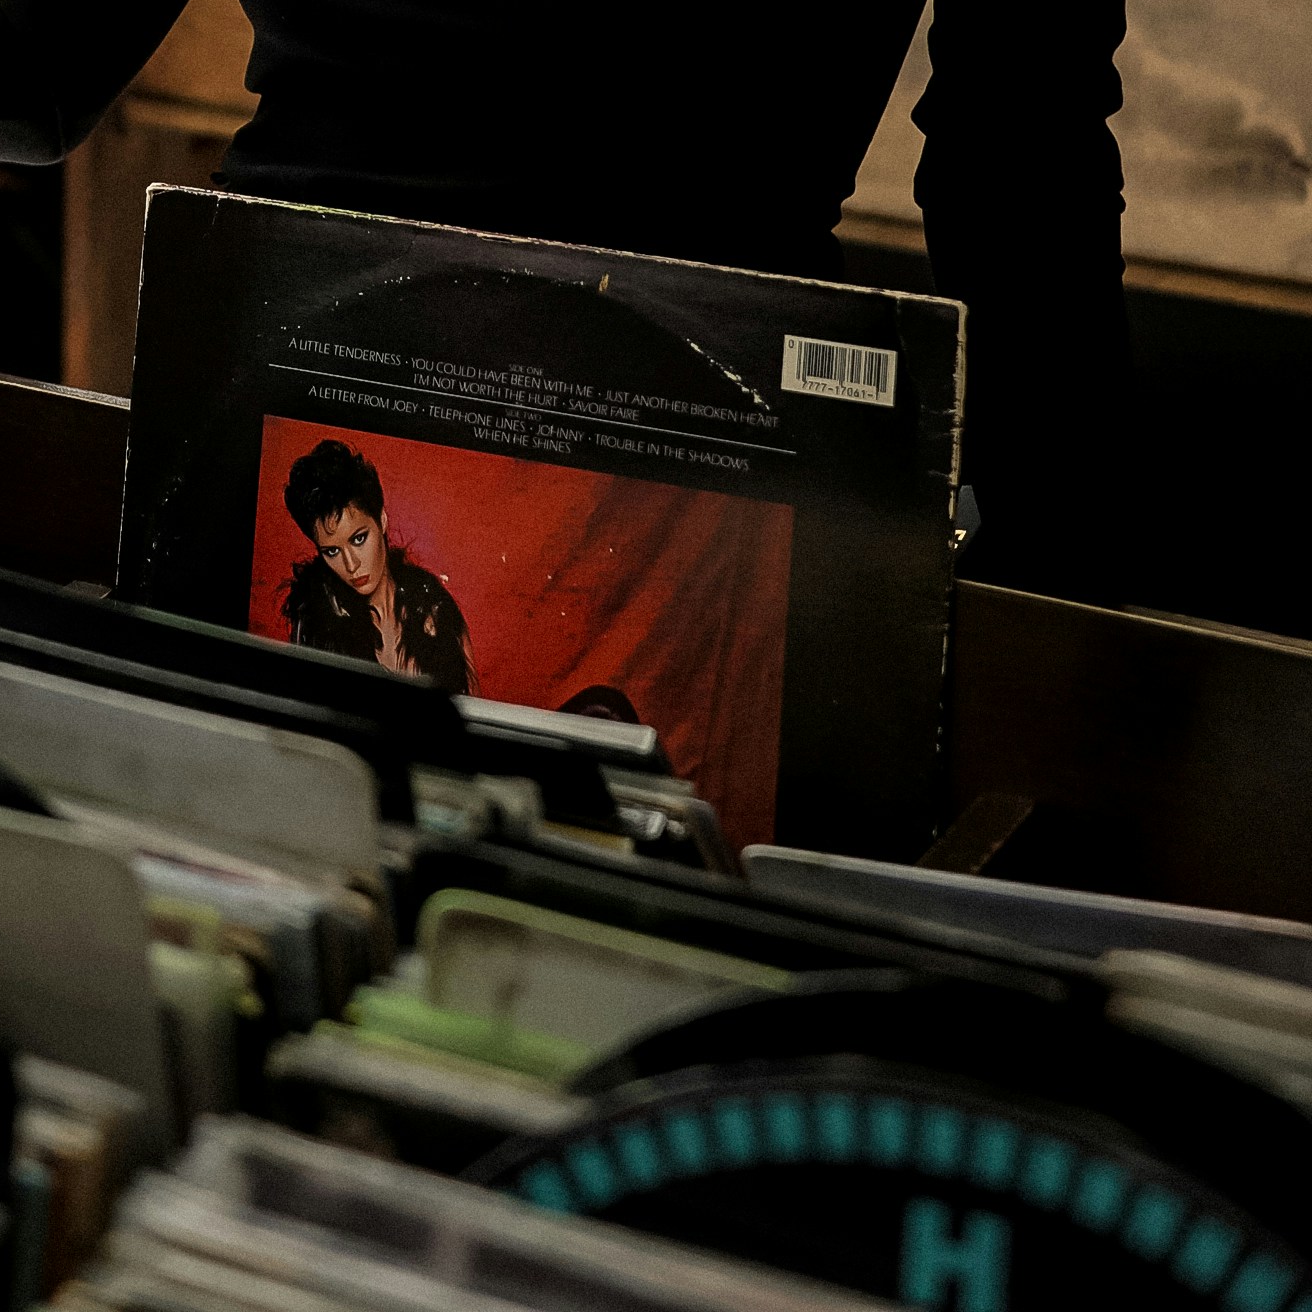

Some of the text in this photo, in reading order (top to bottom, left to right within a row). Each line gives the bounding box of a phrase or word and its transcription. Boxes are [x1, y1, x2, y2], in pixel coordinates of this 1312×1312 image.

[289, 337, 780, 429] A LITTLE TENDERNESS YOU COULD HAVE BEEN WITH ME JUST ANOTHER BROKEN HEART
[413, 373, 640, 422] I'M NOT WORTH THE HURT SAVOIR FAIRE
[308, 385, 750, 472] A LETTER FROM JOEY TELEPHONE LINES JOHNNY TROUBLE IN THE SHADOWS
[473, 426, 572, 454] WHEN HE SHINES
[900, 1199, 1011, 1312] H
